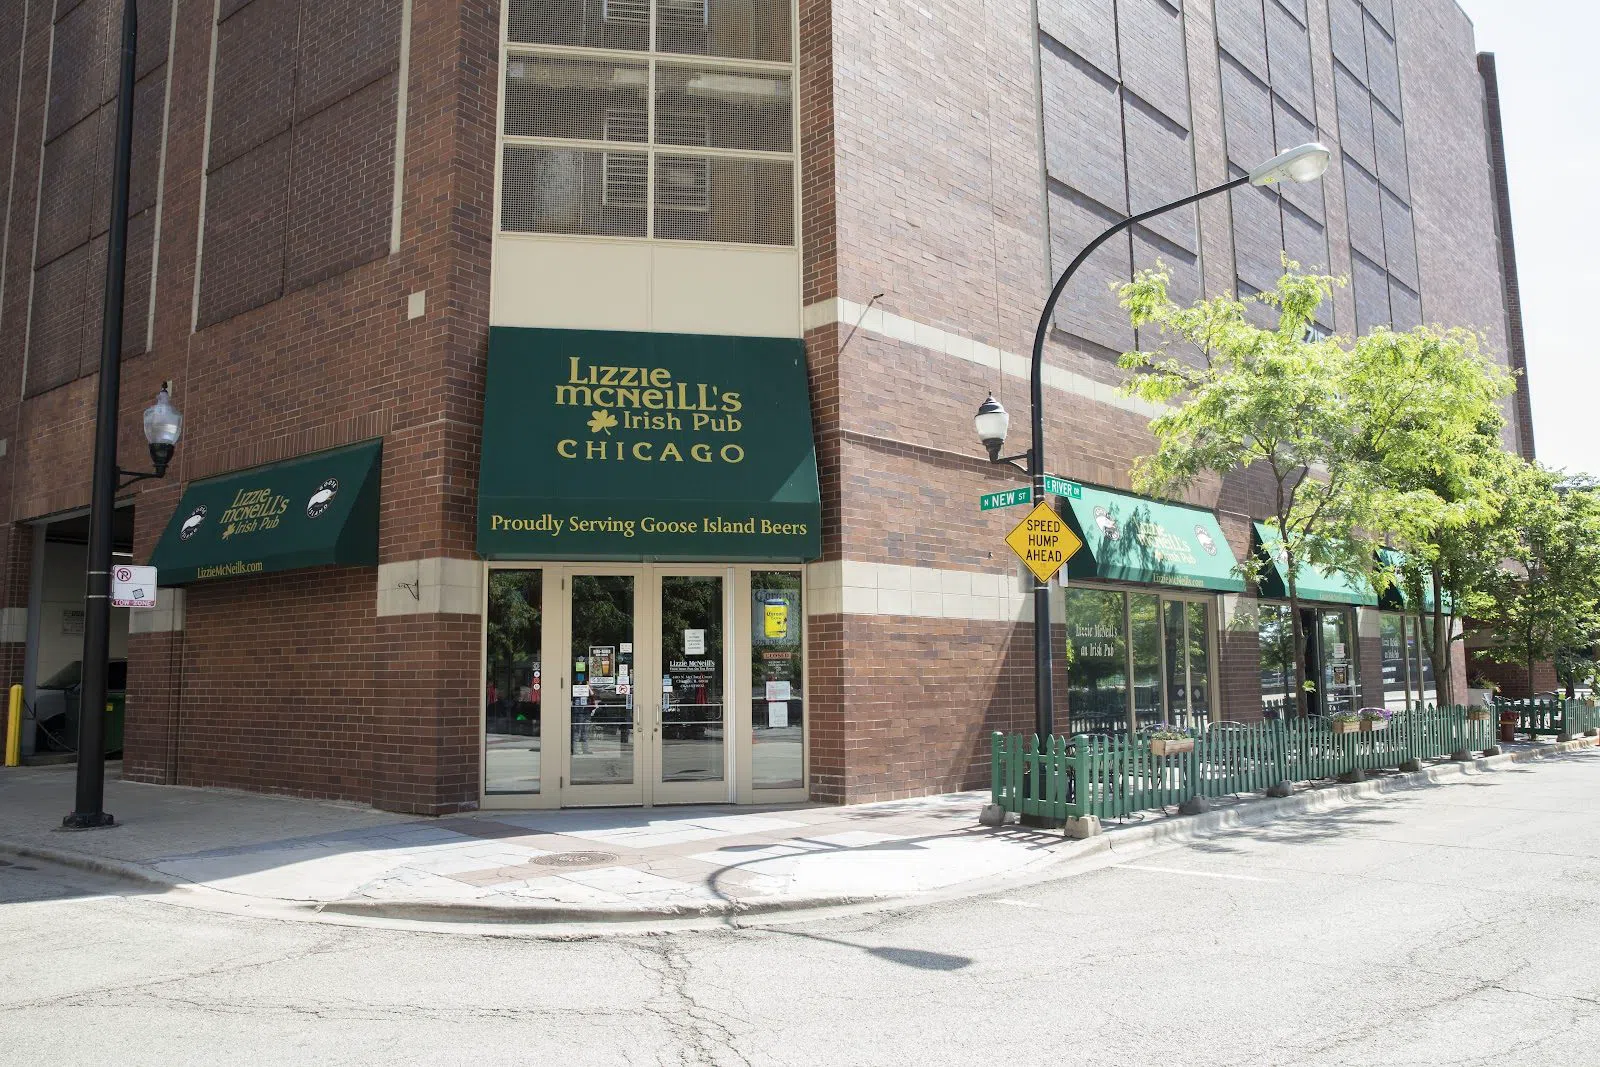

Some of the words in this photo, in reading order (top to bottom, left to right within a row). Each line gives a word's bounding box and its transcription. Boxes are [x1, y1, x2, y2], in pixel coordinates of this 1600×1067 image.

[623, 410, 682, 431] Irish
[692, 412, 743, 433] Pub
[556, 439, 745, 464] CHICAGO
[1047, 480, 1051, 489] E
[1051, 480, 1072, 496] RIVER
[1073, 487, 1080, 496] DR
[984, 498, 989, 506] N
[991, 491, 1016, 507] NEW
[1018, 491, 1026, 501] ST
[234, 518, 258, 535] Irish
[258, 514, 280, 531] Pub
[491, 513, 564, 537] Proudly
[569, 516, 636, 538] Serving
[640, 516, 698, 534] Goose
[703, 517, 755, 534] Island
[760, 518, 807, 536] Beers
[1027, 519, 1061, 533] SPEED
[1028, 534, 1059, 548] HUMP
[1025, 549, 1062, 562] AHEAD
[197, 560, 263, 579] LizzieMcNeills.com
[669, 660, 688, 668] Lizzie
